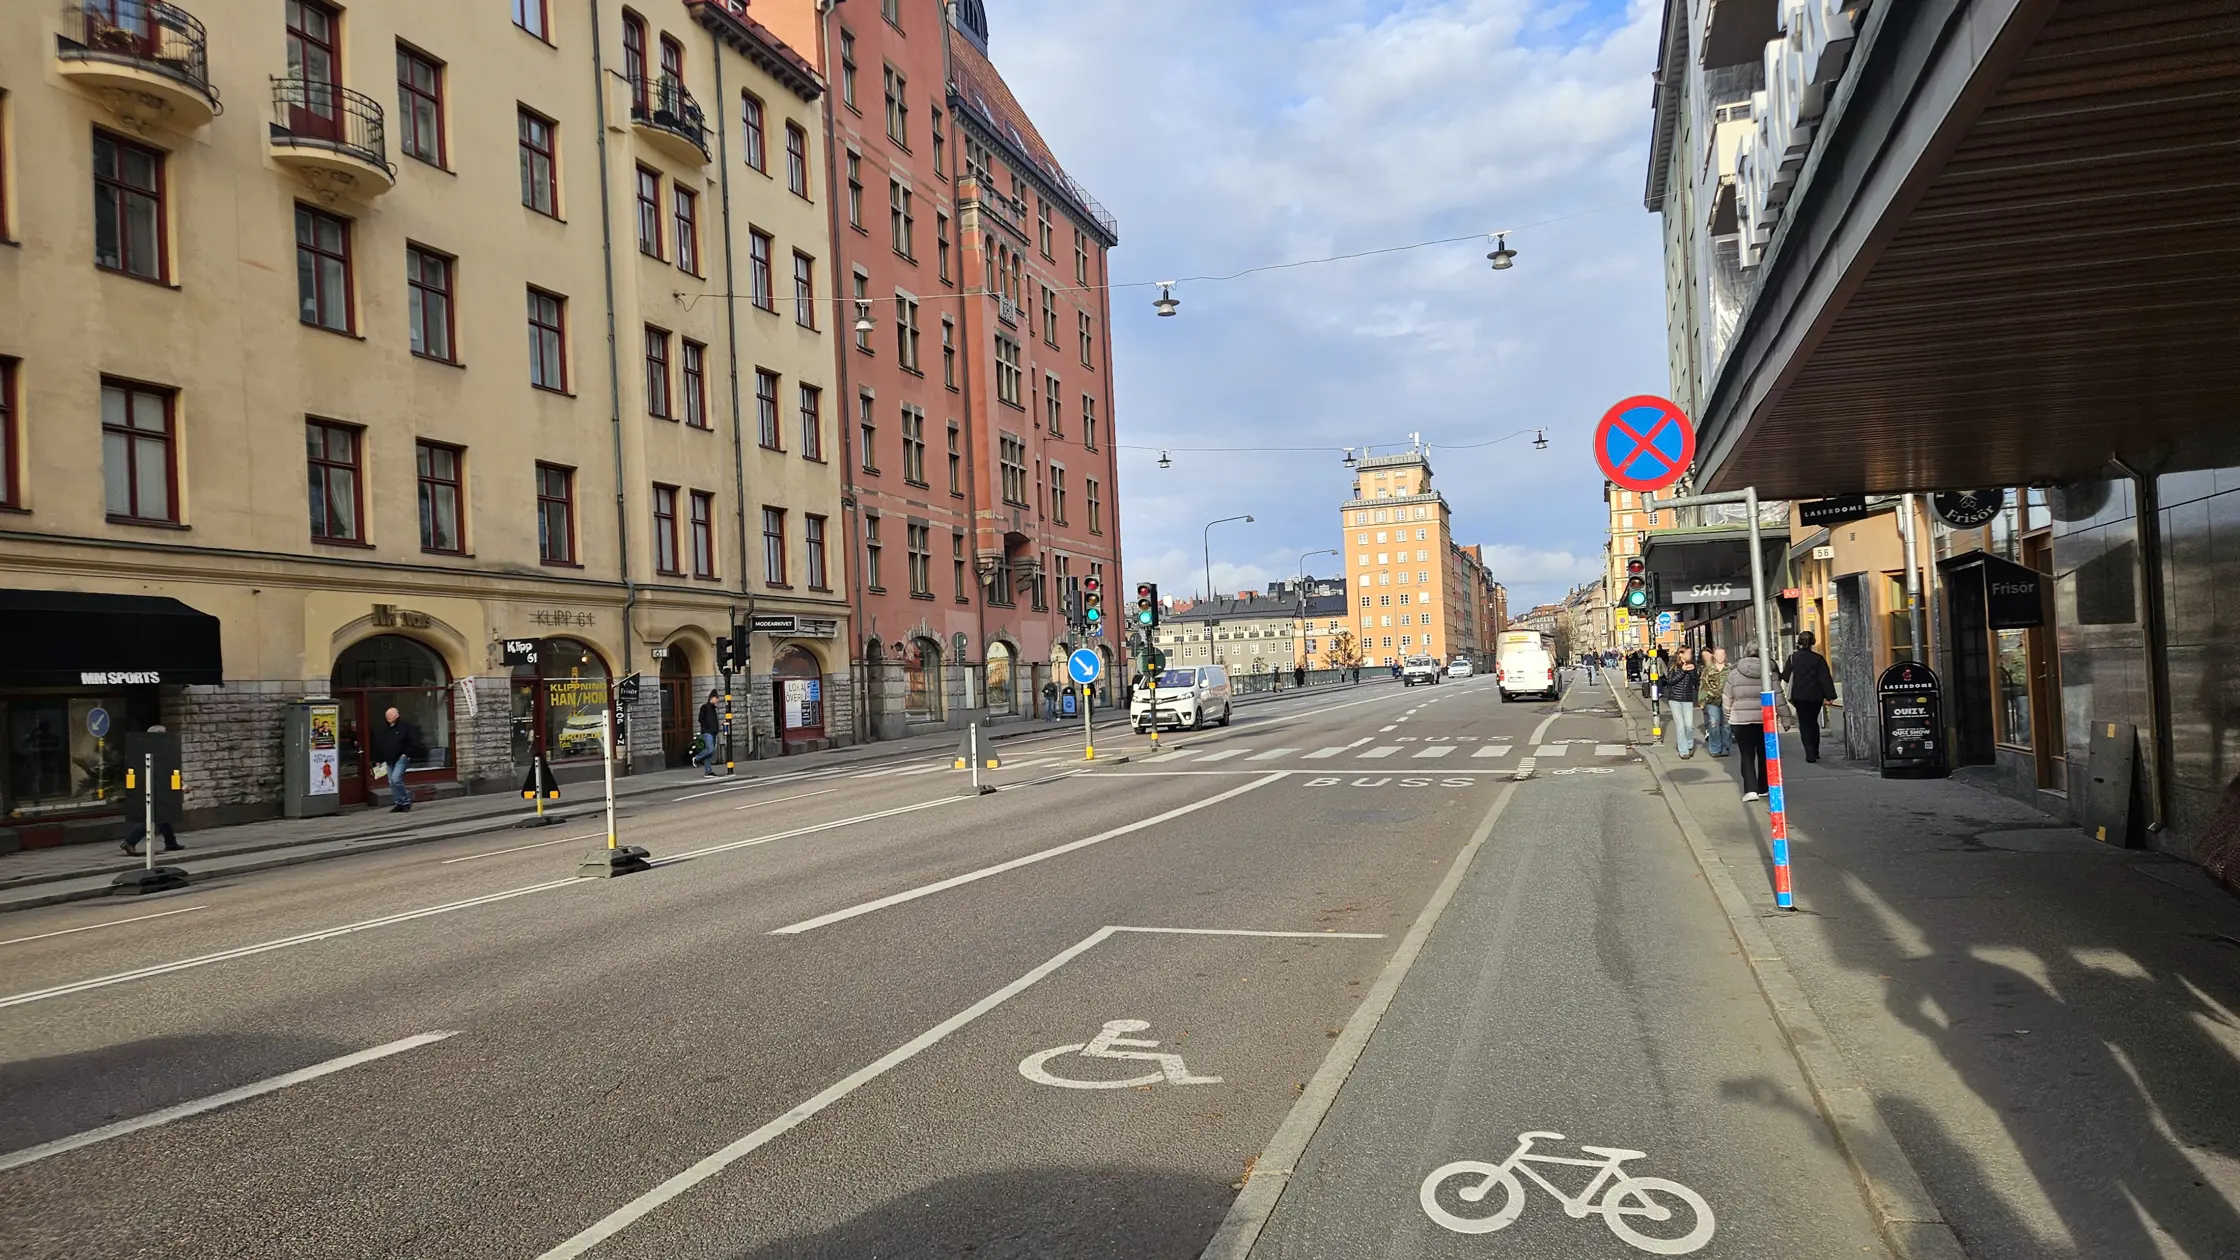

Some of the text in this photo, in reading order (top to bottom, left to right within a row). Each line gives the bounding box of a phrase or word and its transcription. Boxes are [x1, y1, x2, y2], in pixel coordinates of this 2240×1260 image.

[1804, 505, 1862, 517] LASERDOME
[1944, 505, 1995, 523] Frisör
[1817, 549, 1829, 557] 56
[1690, 582, 1732, 597] SATS
[1992, 581, 2034, 595] Frisör
[537, 610, 593, 627] KLIPP 61
[507, 641, 533, 654] Klipp
[526, 653, 538, 663] 61
[81, 671, 160, 684] MM SPORTS
[1302, 777, 1475, 787] BUSS
